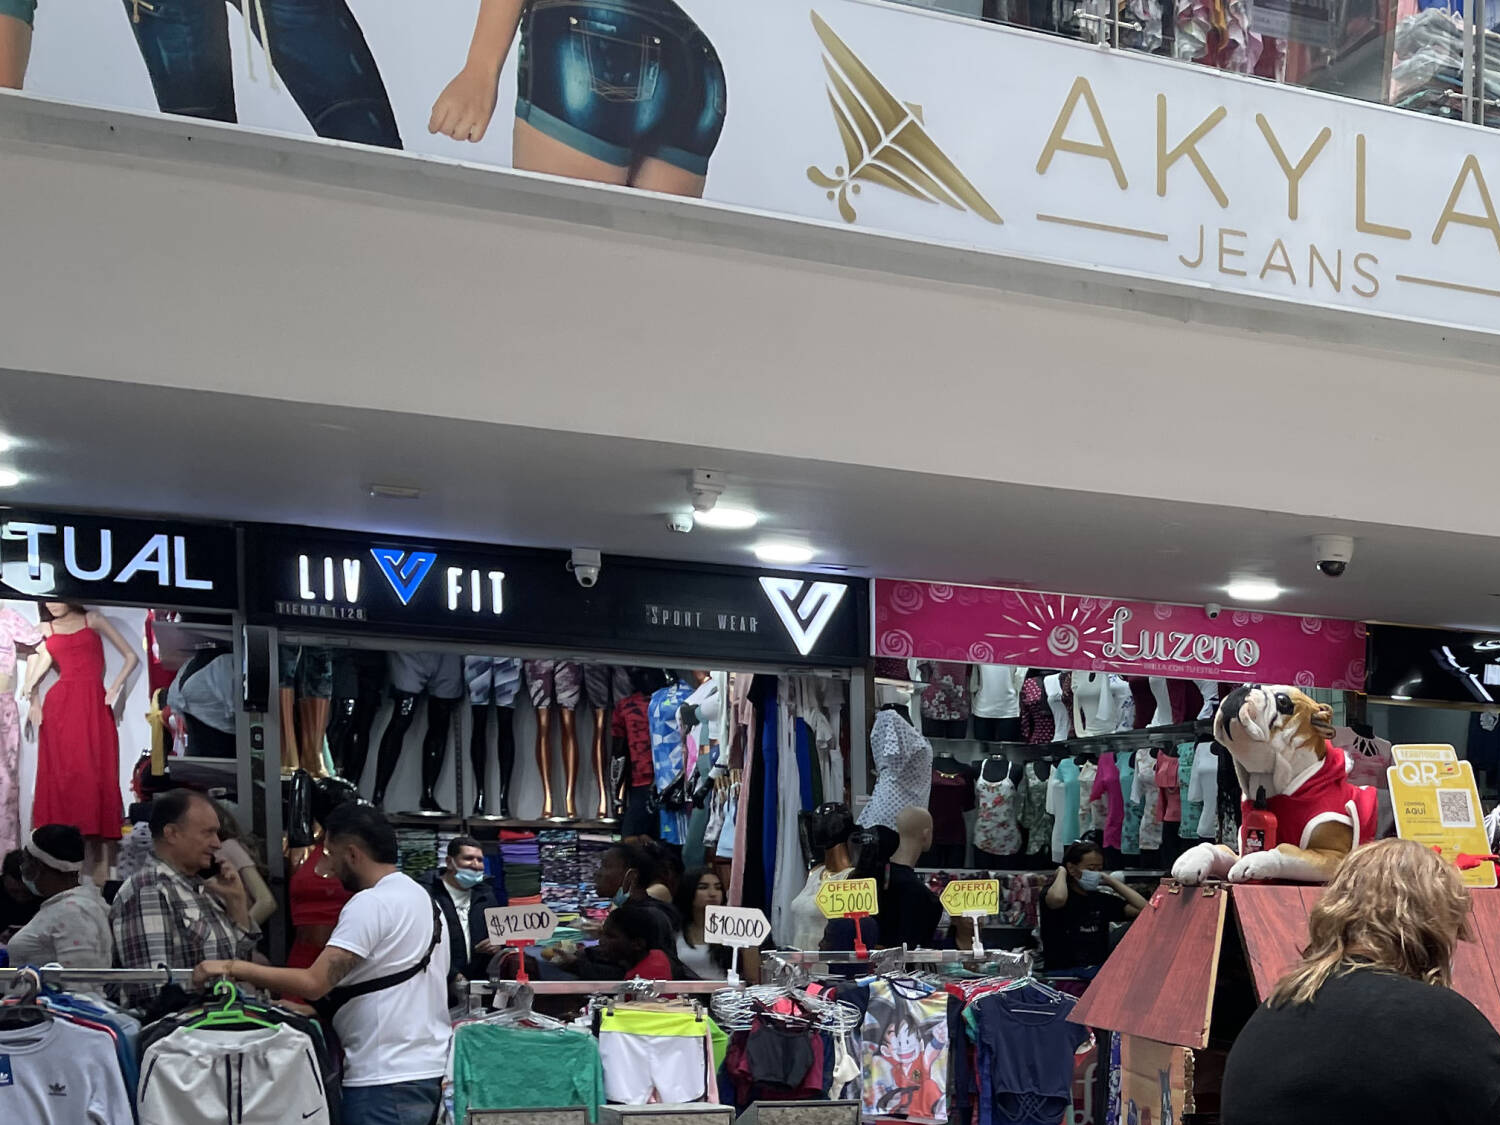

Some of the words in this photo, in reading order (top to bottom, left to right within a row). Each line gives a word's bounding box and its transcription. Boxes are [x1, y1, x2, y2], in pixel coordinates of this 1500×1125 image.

[1179, 225, 1381, 298] JEANS
[7, 521, 214, 590] TUAL
[299, 554, 361, 603] LIV
[447, 566, 505, 614] FIT
[277, 602, 326, 617] TIENDA
[651, 606, 701, 628] SPORT
[717, 613, 758, 634] WEAR
[1103, 606, 1260, 667] Luzero
[1399, 761, 1440, 786] QR
[828, 882, 870, 892] OFERTA
[953, 882, 993, 892] OFERTA
[705, 913, 764, 938] $10.000
